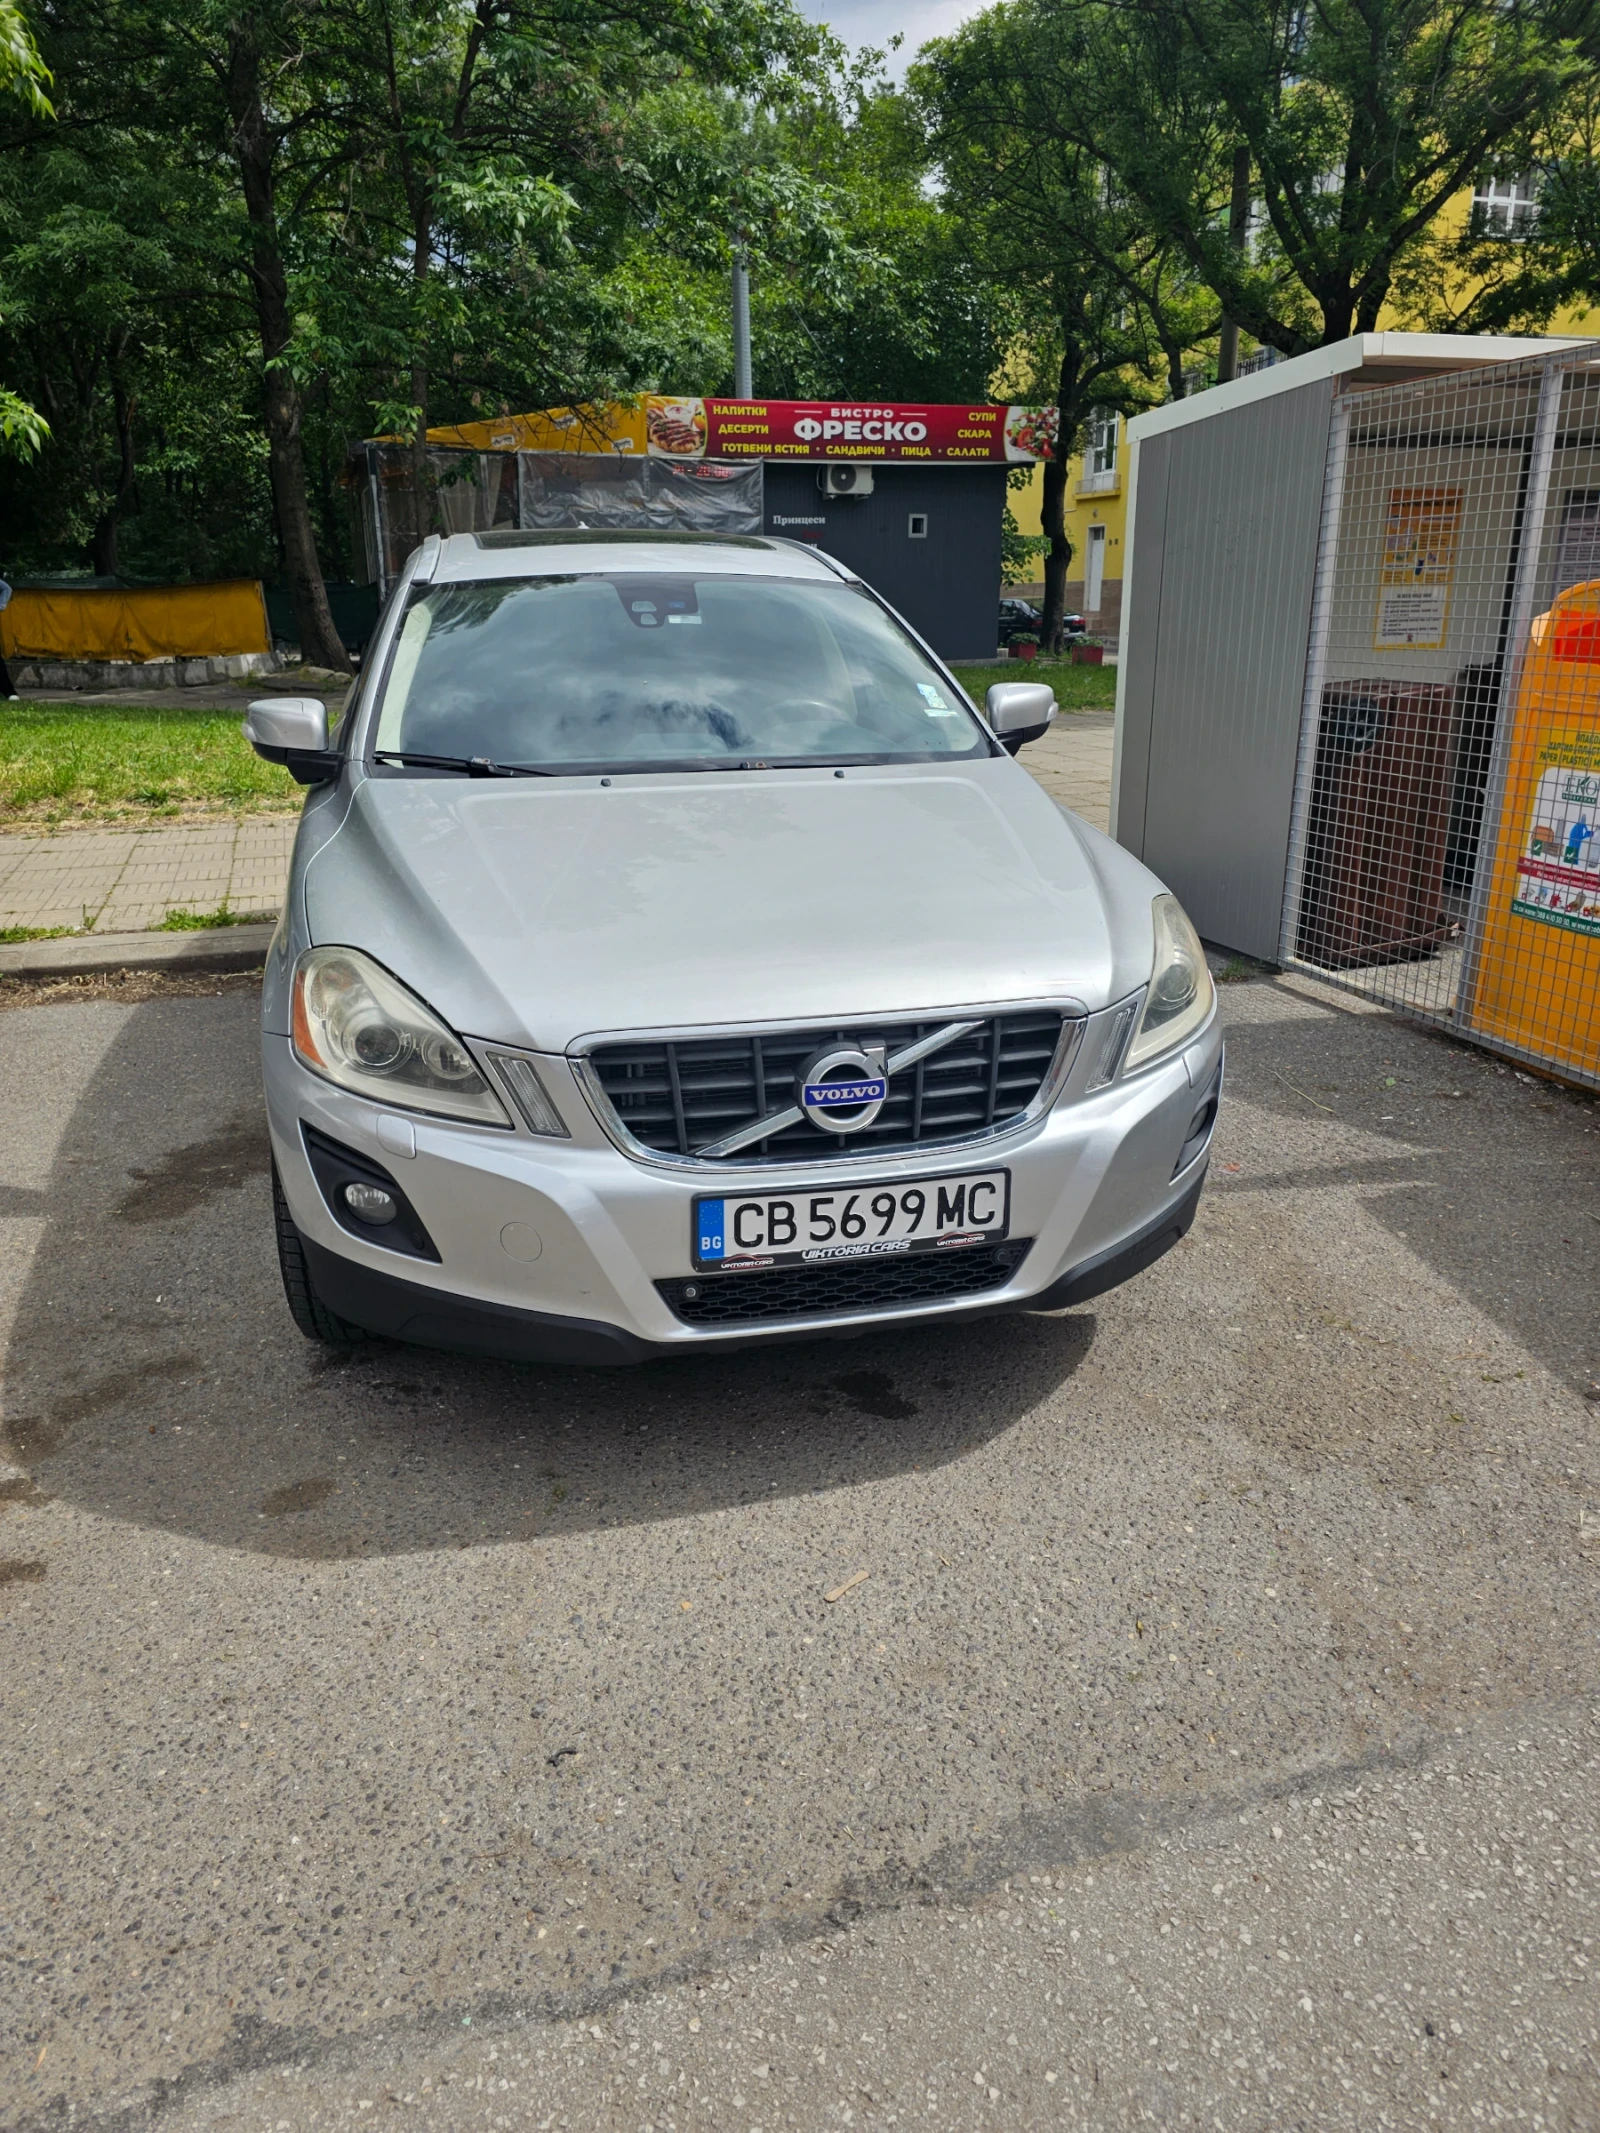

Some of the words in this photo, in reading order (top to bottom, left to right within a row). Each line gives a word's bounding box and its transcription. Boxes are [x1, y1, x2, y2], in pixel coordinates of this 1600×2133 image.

[713, 405, 767, 416] НАПИТКИ
[830, 407, 894, 419] БИСТРО
[968, 412, 997, 422] СУПИ
[718, 424, 769, 435] ДЕСЕРТИ
[793, 417, 927, 442] ФРЕСКО
[957, 429, 992, 439] СКАРА
[722, 443, 772, 453] ГОТВЕНИ
[774, 444, 810, 454] ЯСТИЯ
[826, 445, 885, 456] САНДВИЧИ
[901, 447, 931, 457] ПИЦА
[946, 447, 990, 457] САЛАТИ
[773, 515, 826, 527] Принцеси
[1562, 754, 1588, 767] PLASTIC
[808, 1084, 881, 1102] VOLVO
[733, 1200, 797, 1248] CB
[809, 1189, 926, 1242] 5699
[936, 1181, 996, 1230] MC
[701, 1236, 722, 1251] BG
[802, 1244, 871, 1260] VIKTORIA
[871, 1239, 911, 1253] CARS
